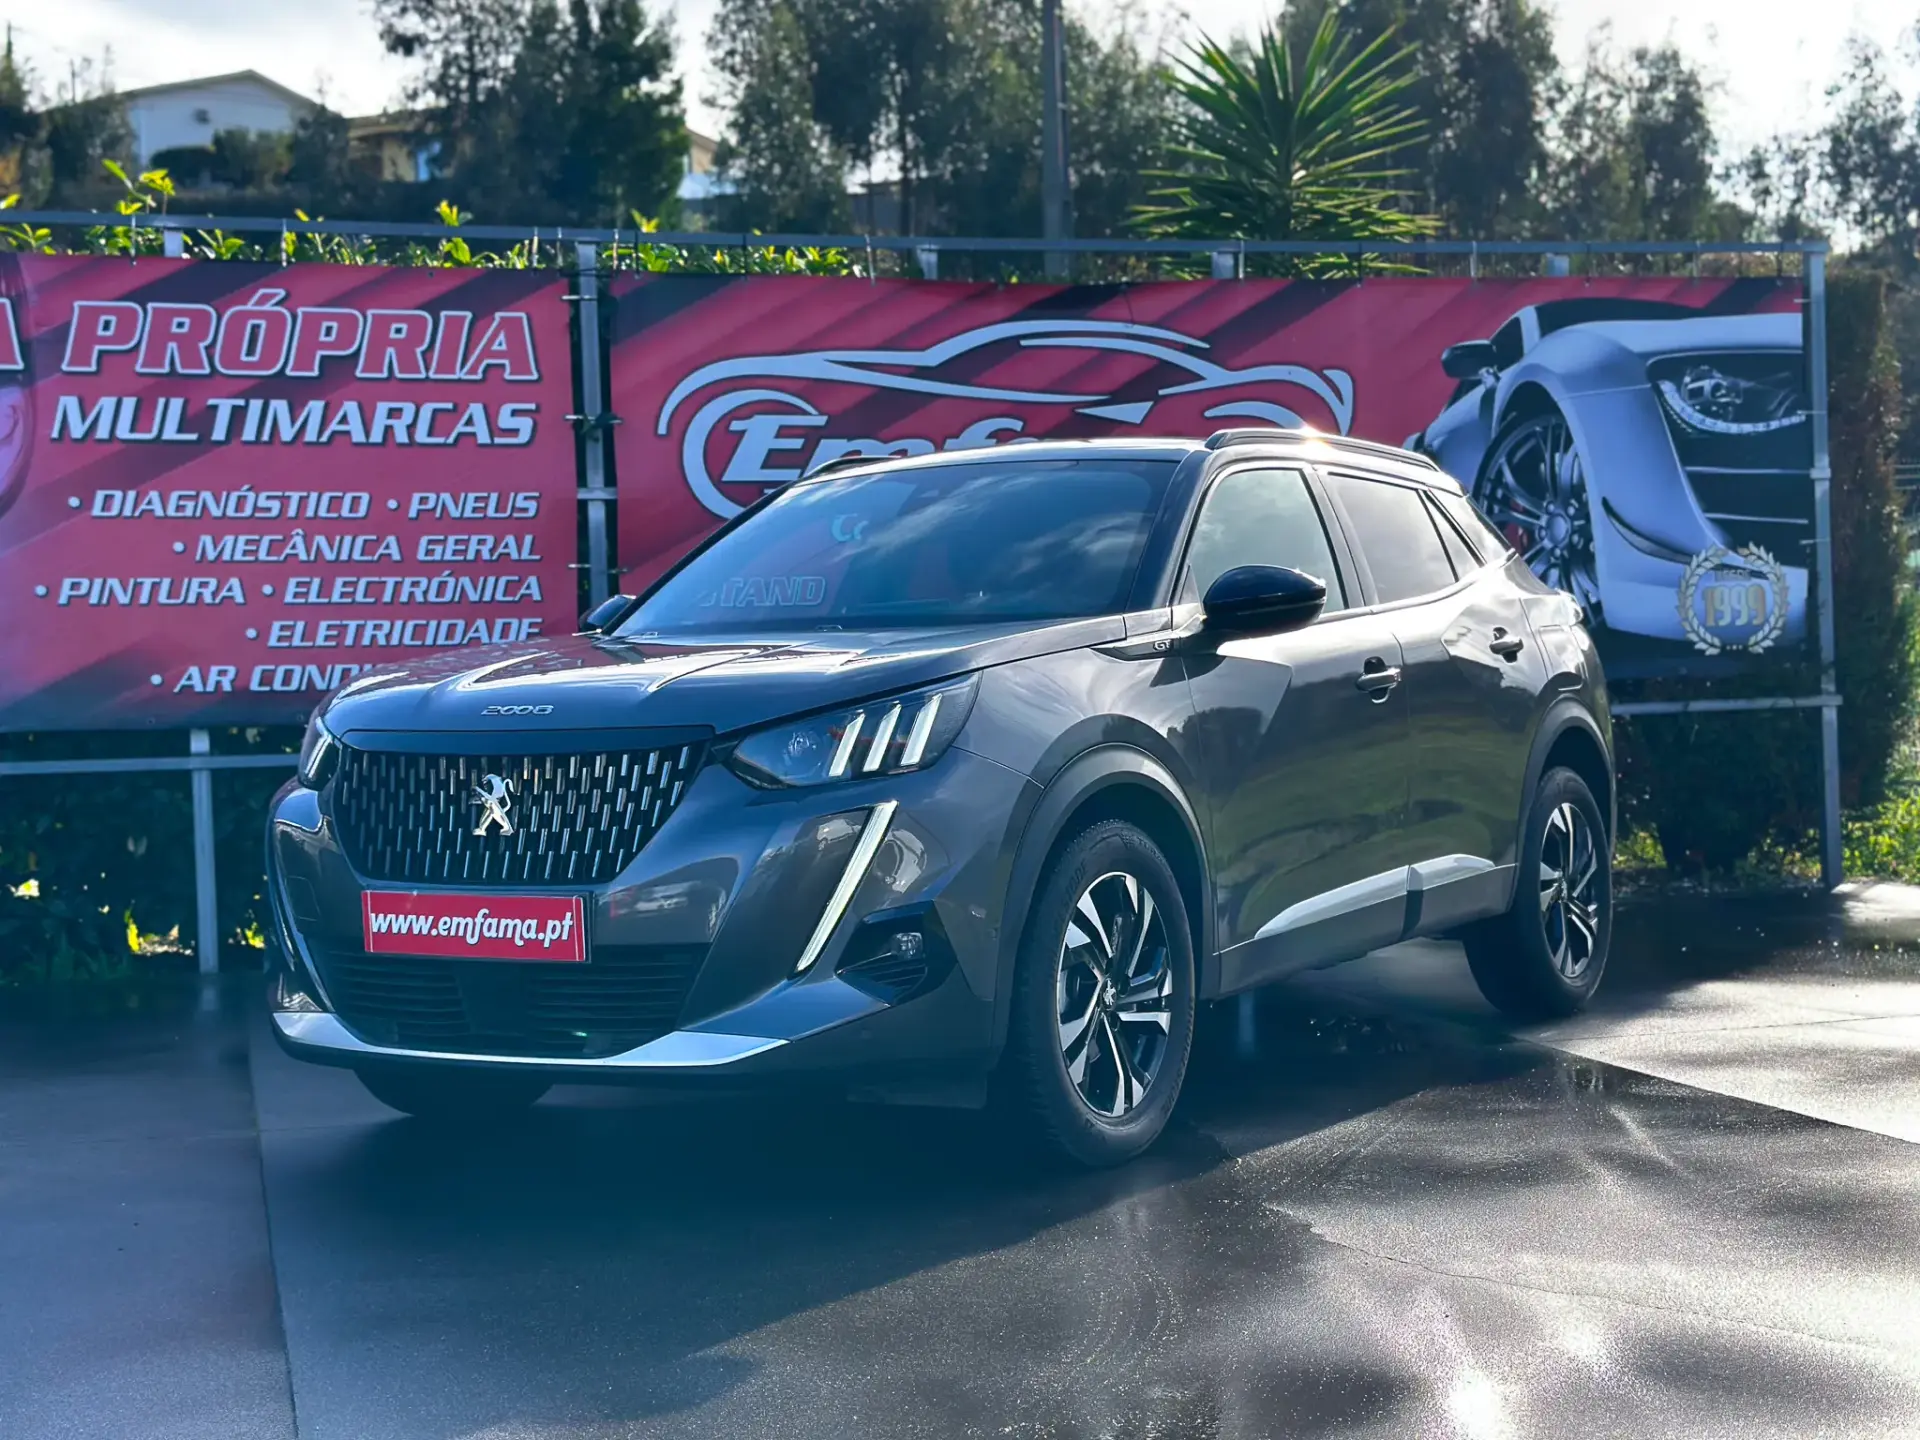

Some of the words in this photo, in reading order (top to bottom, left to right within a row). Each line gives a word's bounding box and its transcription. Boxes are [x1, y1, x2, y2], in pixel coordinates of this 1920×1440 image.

[61, 288, 541, 381] PRÓPRIA
[50, 395, 538, 446] MULTIMARCAS
[90, 485, 370, 519] DIAGNÓSTICO
[407, 491, 541, 519] PNEUS
[194, 529, 402, 563] MECÂNICA
[416, 534, 541, 562] GERAL
[57, 577, 245, 607] PINTURA
[282, 572, 542, 605] ELECTRÓNICA
[1702, 583, 1767, 628] 1999
[173, 665, 236, 693] AR
[369, 908, 573, 948] www.emfama.pt
